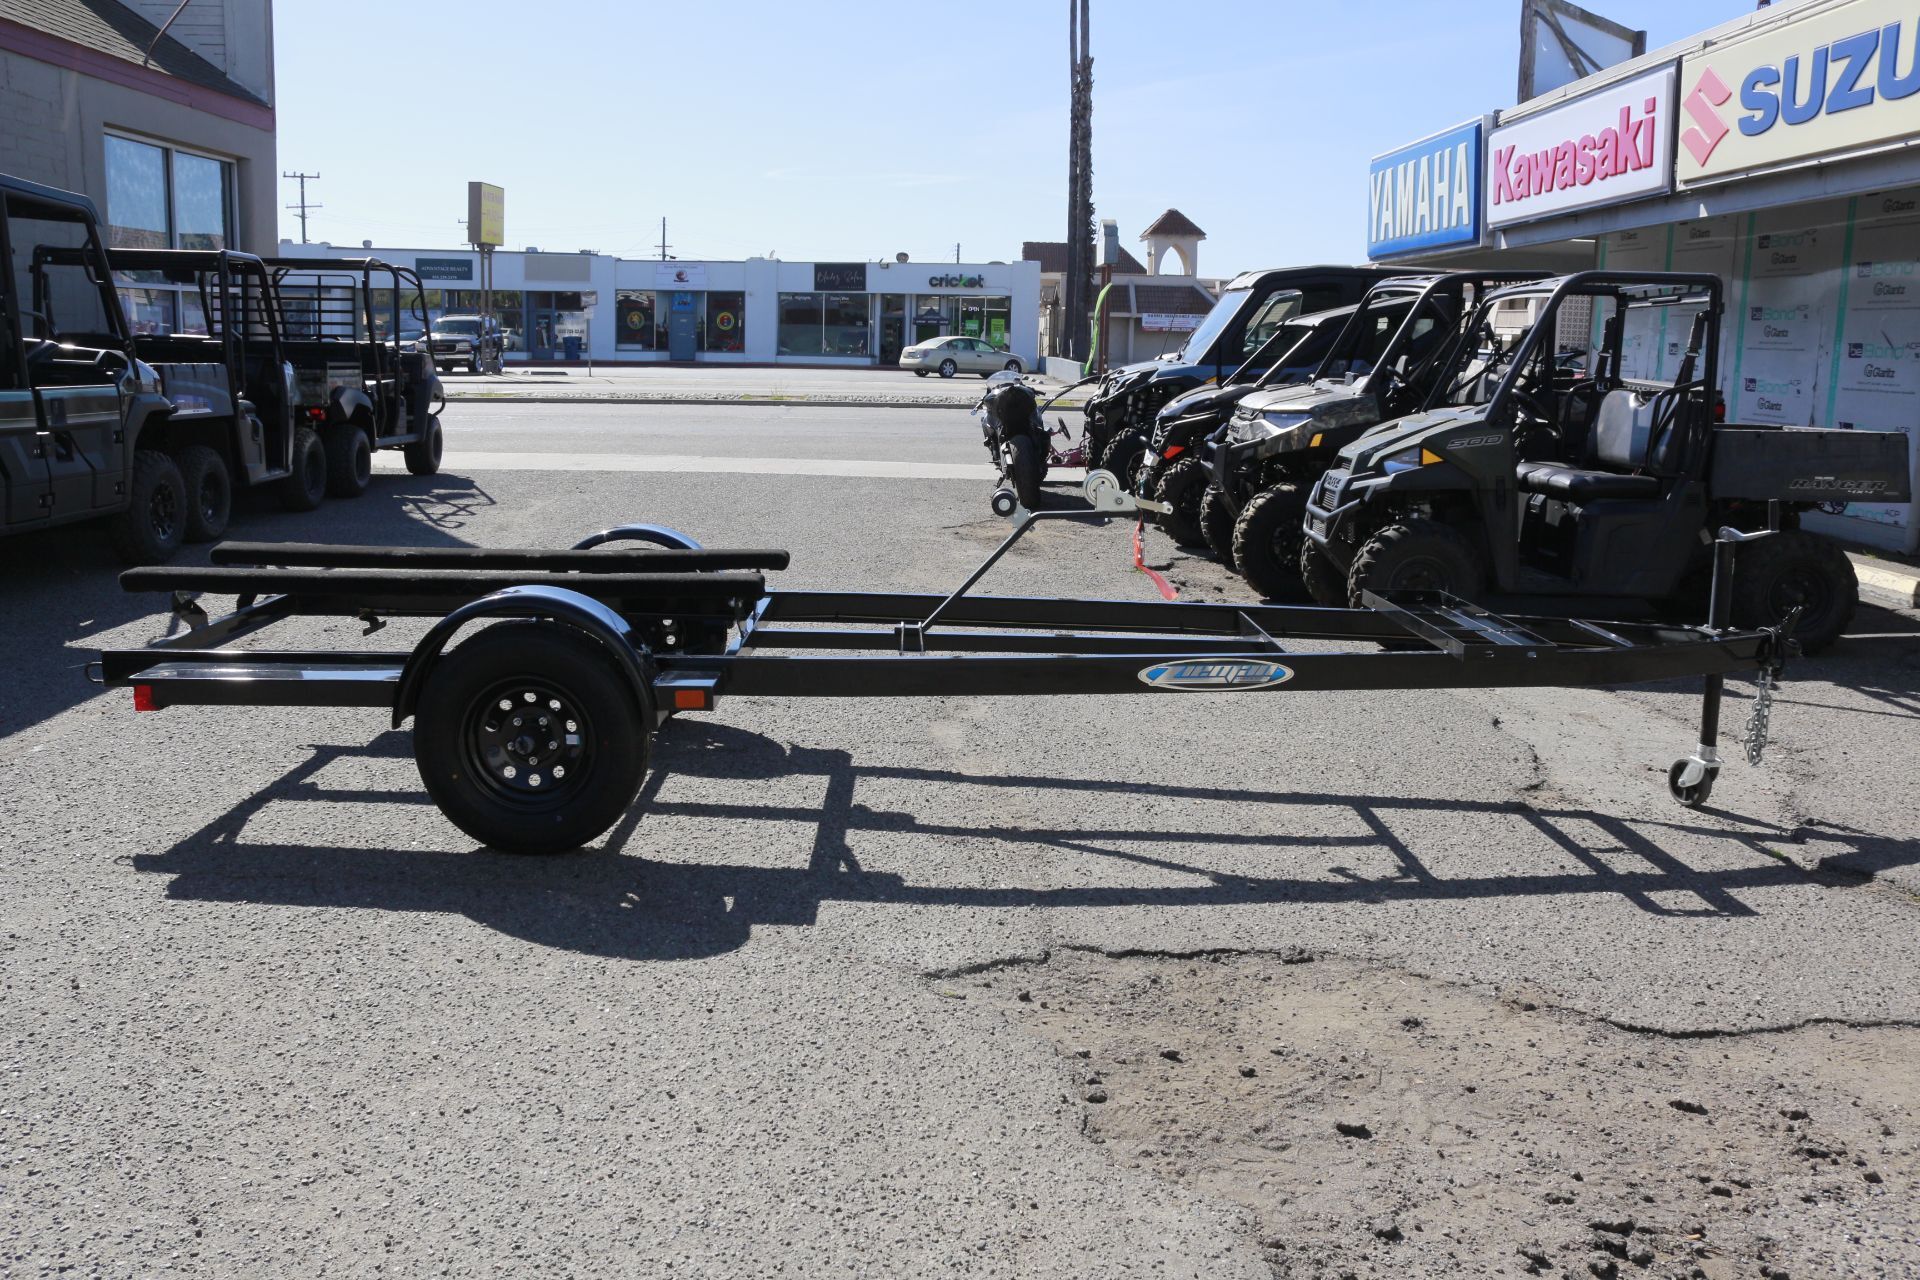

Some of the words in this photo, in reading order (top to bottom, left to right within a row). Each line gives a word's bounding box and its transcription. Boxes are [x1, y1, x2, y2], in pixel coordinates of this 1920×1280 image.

[1491, 96, 1656, 204] Kawasaki
[1370, 142, 1470, 243] YAMAHA
[928, 274, 984, 289] cricket
[1447, 434, 1504, 450] 500
[1789, 479, 1888, 490] RANGER
